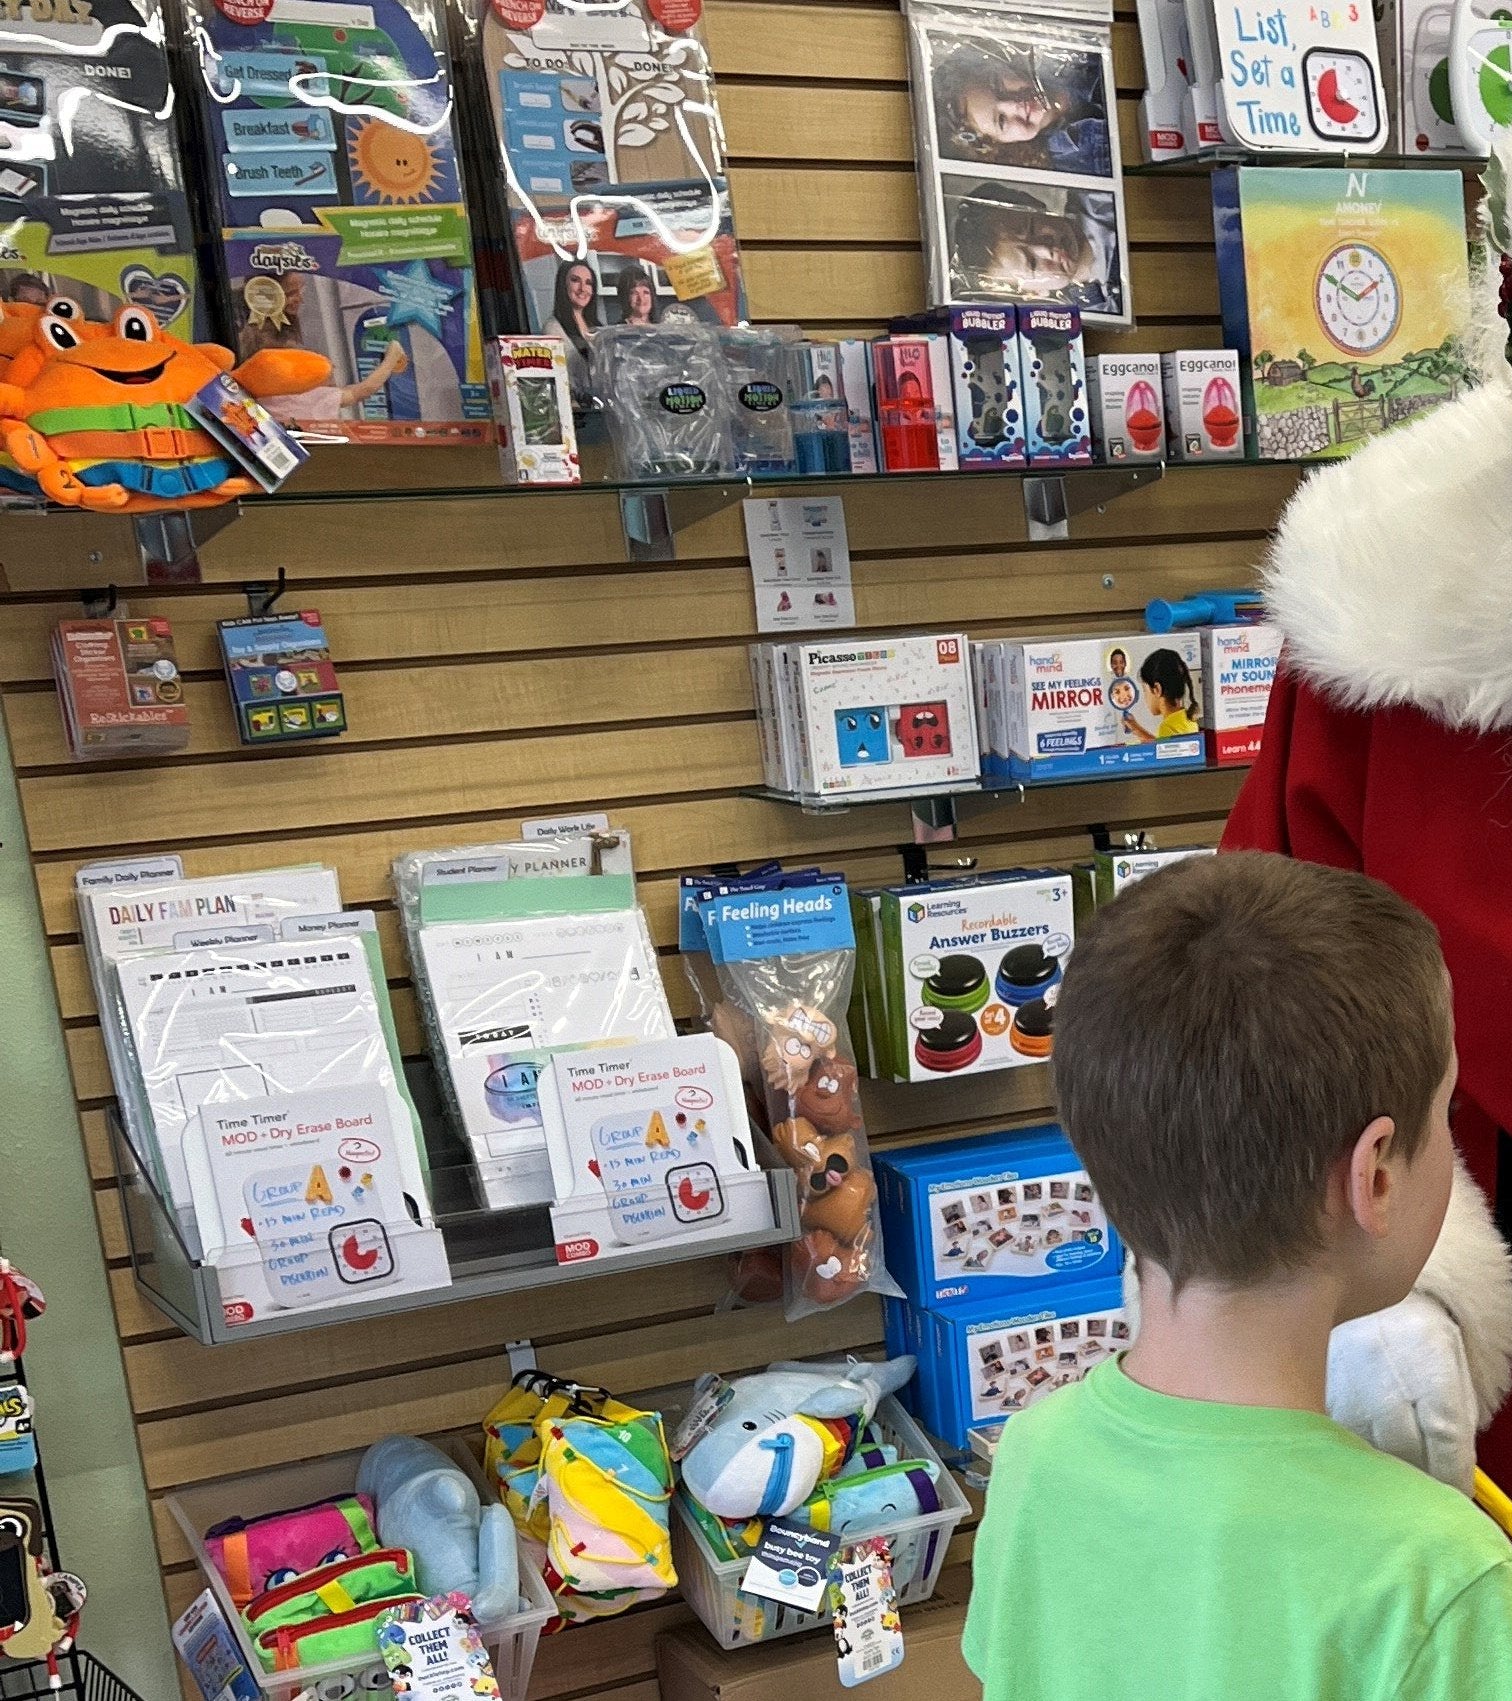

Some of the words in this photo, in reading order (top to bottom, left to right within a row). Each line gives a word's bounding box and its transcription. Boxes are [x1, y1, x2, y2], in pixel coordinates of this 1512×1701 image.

[523, 57, 541, 69] TO
[1231, 50, 1273, 89] Set
[1281, 65, 1295, 88] a
[1236, 101, 1300, 136] Time
[233, 122, 290, 136] Breakfast
[271, 164, 303, 178] Teeth
[962, 318, 1006, 330] BUBBLER
[1031, 318, 1072, 329] BUBBLER
[1031, 681, 1046, 691] SEE
[1048, 680, 1062, 690] MY
[1064, 677, 1101, 689] FEELINGS
[1220, 672, 1238, 684] MY
[1242, 669, 1276, 683] SOUN
[1031, 688, 1104, 711] MIRROR
[467, 863, 497, 873] Planner
[524, 857, 587, 873] PLANNER
[82, 877, 114, 886] Family
[115, 873, 139, 882] Daily
[140, 869, 174, 879] Planner
[1052, 888, 1068, 902] 3+
[109, 902, 154, 925] DAILY
[158, 899, 194, 919] FAM
[196, 894, 237, 915] PLAN
[722, 902, 780, 921] Feeling
[783, 894, 833, 915] Heads
[926, 900, 961, 911] Learning
[926, 908, 967, 919] Resources
[327, 919, 360, 929] Planner
[961, 913, 1018, 932] Recordable
[224, 933, 258, 943] Planner
[929, 932, 987, 950] Answer
[991, 924, 1050, 942] Buzzers
[994, 1008, 1006, 1024] 4
[568, 1065, 595, 1078] Time
[598, 1060, 630, 1074] Timer
[572, 1078, 604, 1092] MOD
[615, 1074, 635, 1088] Dry
[639, 1070, 670, 1084] Erase
[673, 1063, 706, 1077] Board
[217, 1118, 248, 1131] Time
[251, 1111, 288, 1126] Timer
[222, 1131, 257, 1147] MOD
[270, 1126, 293, 1141] Dry
[297, 1122, 332, 1136] Erase
[336, 1114, 373, 1130] Board
[645, 1111, 671, 1149] A
[305, 1165, 334, 1206] A
[565, 1241, 591, 1253] MOD
[224, 1305, 244, 1317] OD
[786, 1547, 805, 1559] bee
[805, 1553, 821, 1566] toy
[845, 1565, 873, 1583] COLLECT
[851, 1577, 870, 1591] THEM
[408, 1627, 451, 1645] COLLECT
[419, 1640, 449, 1655] THEM
[426, 1651, 449, 1665] ALL!
